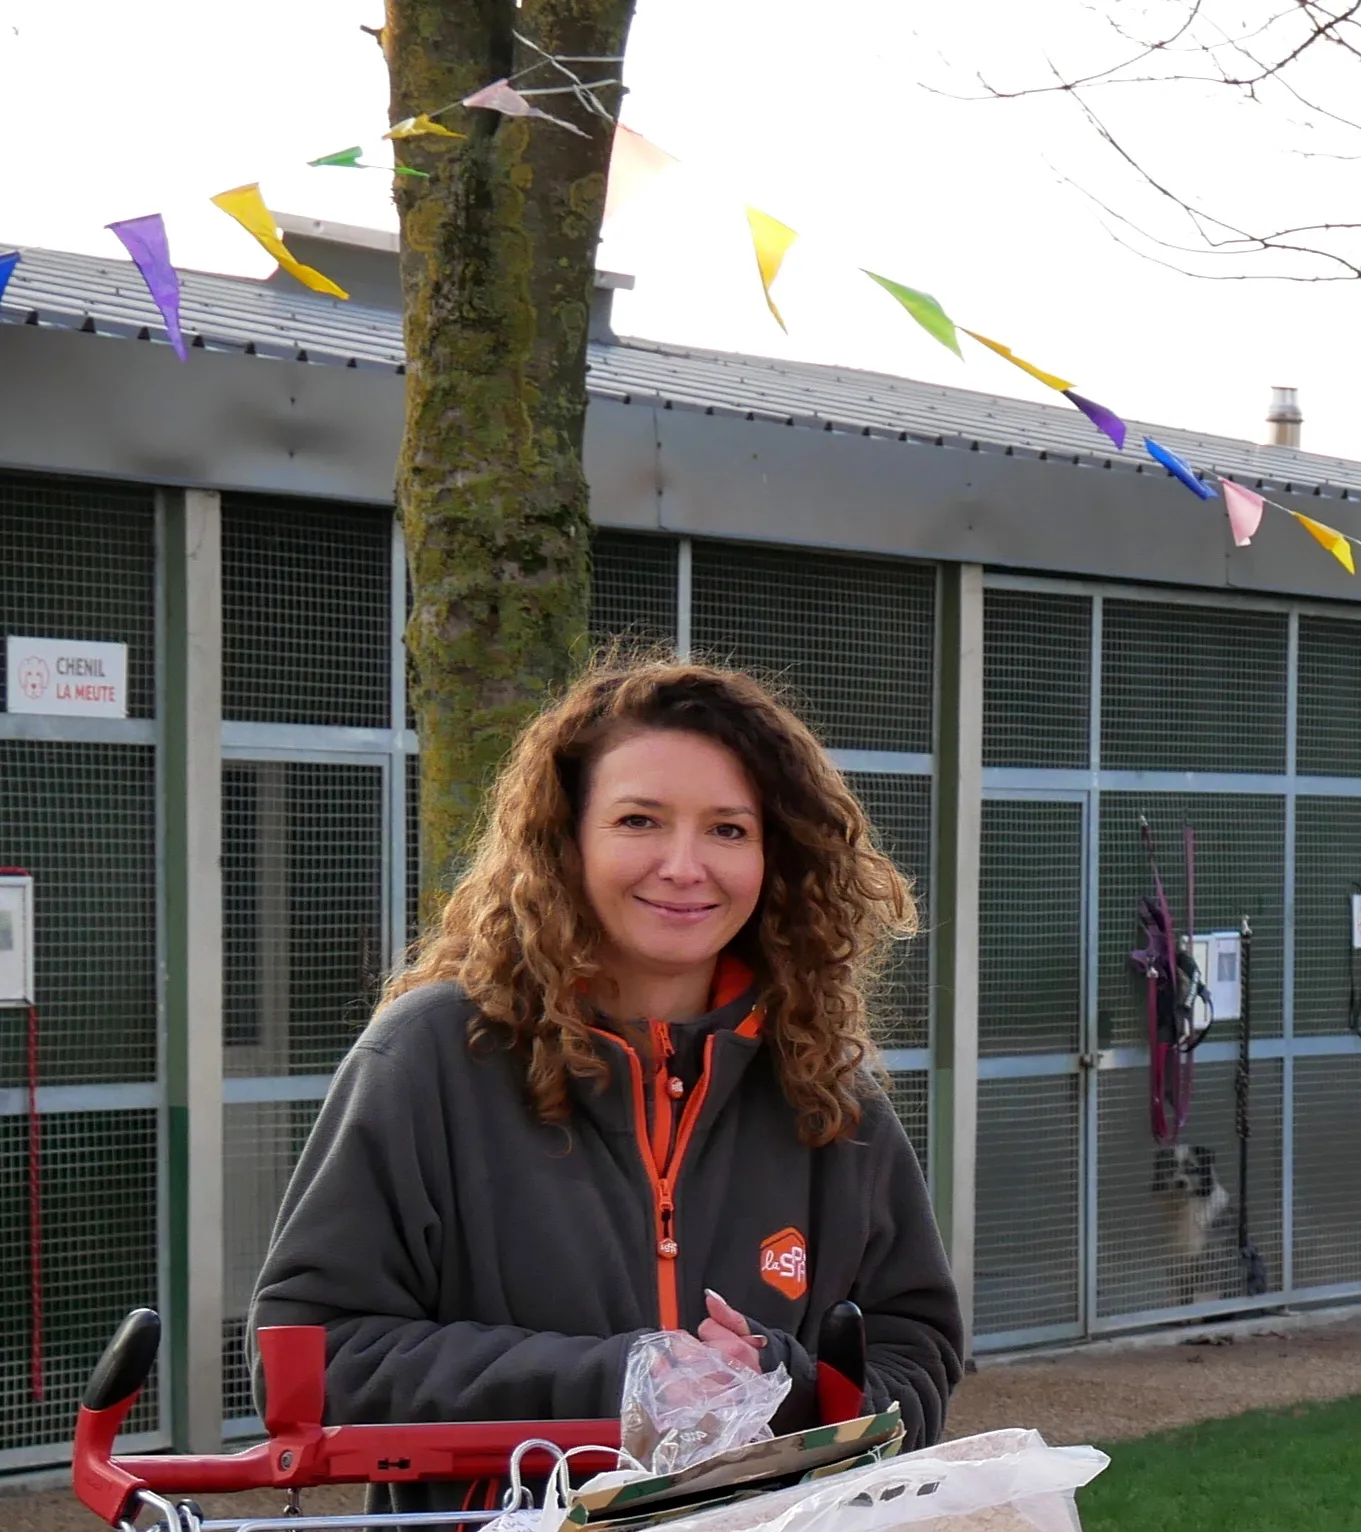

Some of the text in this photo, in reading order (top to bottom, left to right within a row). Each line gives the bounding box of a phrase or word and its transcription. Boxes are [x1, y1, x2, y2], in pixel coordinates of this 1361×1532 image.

[56, 656, 106, 677] CHENIL
[56, 683, 116, 702] LA MEUTE
